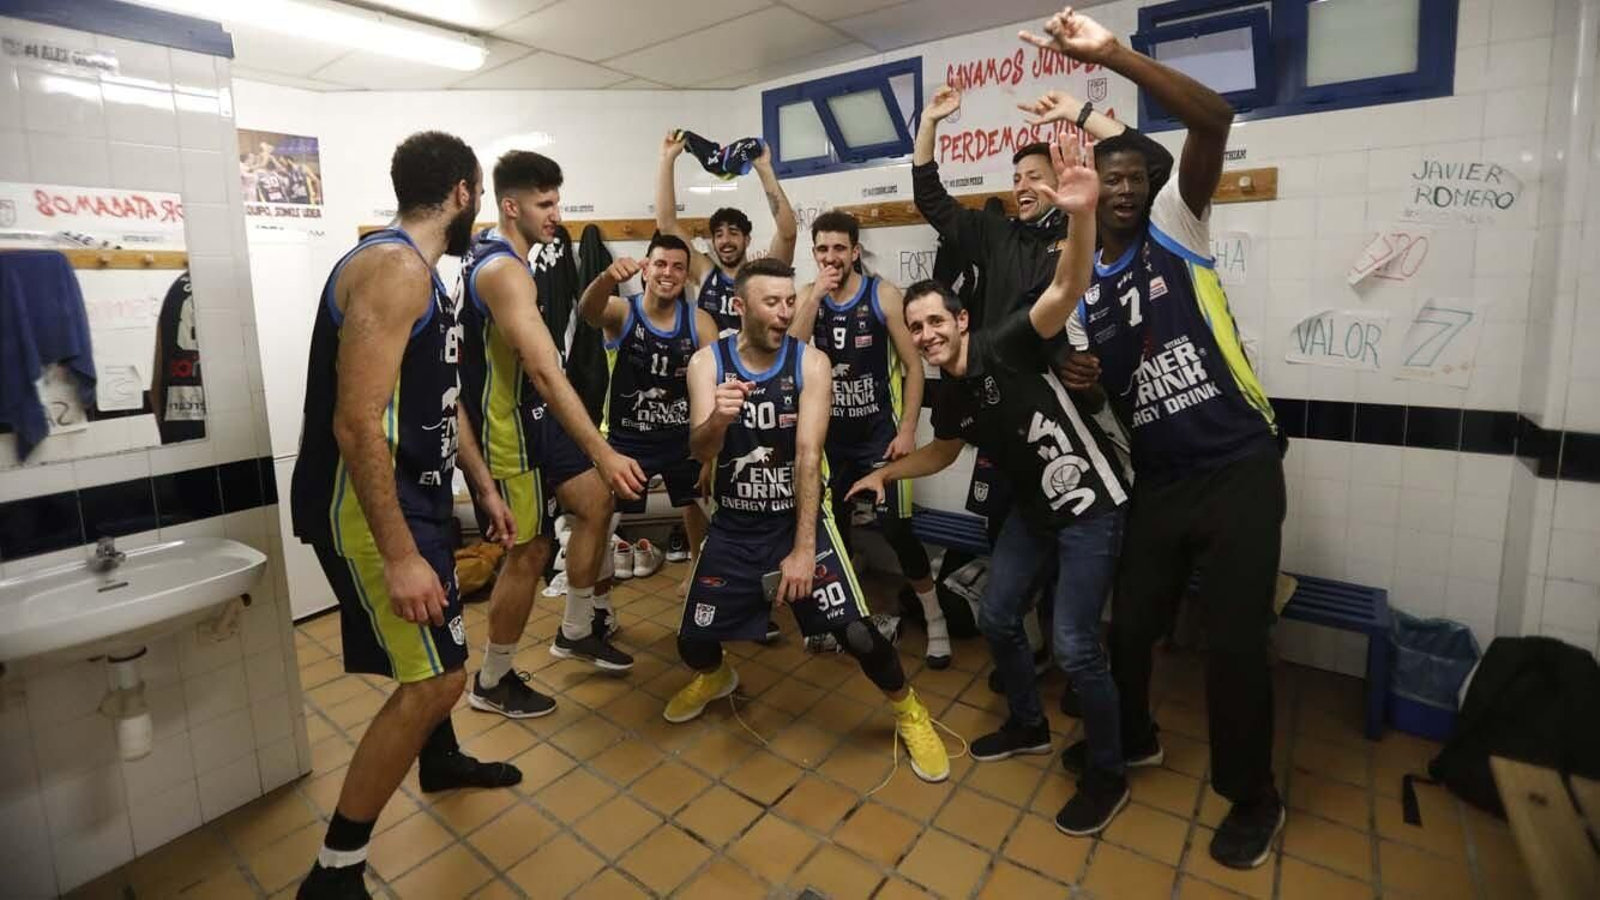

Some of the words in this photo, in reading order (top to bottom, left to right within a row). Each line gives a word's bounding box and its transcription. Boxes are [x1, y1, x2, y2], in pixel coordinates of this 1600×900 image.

[940, 123, 1040, 164] PERDEMOS
[1412, 160, 1502, 182] JAVIER
[1414, 185, 1514, 209] ROMERO
[1119, 287, 1142, 327] 7
[833, 327, 846, 350] 9
[1295, 317, 1383, 369] VALOR
[1405, 306, 1474, 367] 7
[650, 353, 669, 376] 11
[833, 377, 874, 394] ENER
[832, 390, 875, 406] RINK
[1164, 381, 1222, 415] DRINK
[743, 401, 776, 430] 30
[848, 403, 879, 417] DRINK
[750, 466, 796, 483] ENE
[737, 482, 797, 499] DRIN
[721, 496, 767, 511] ENERGY
[813, 581, 846, 612] 30
